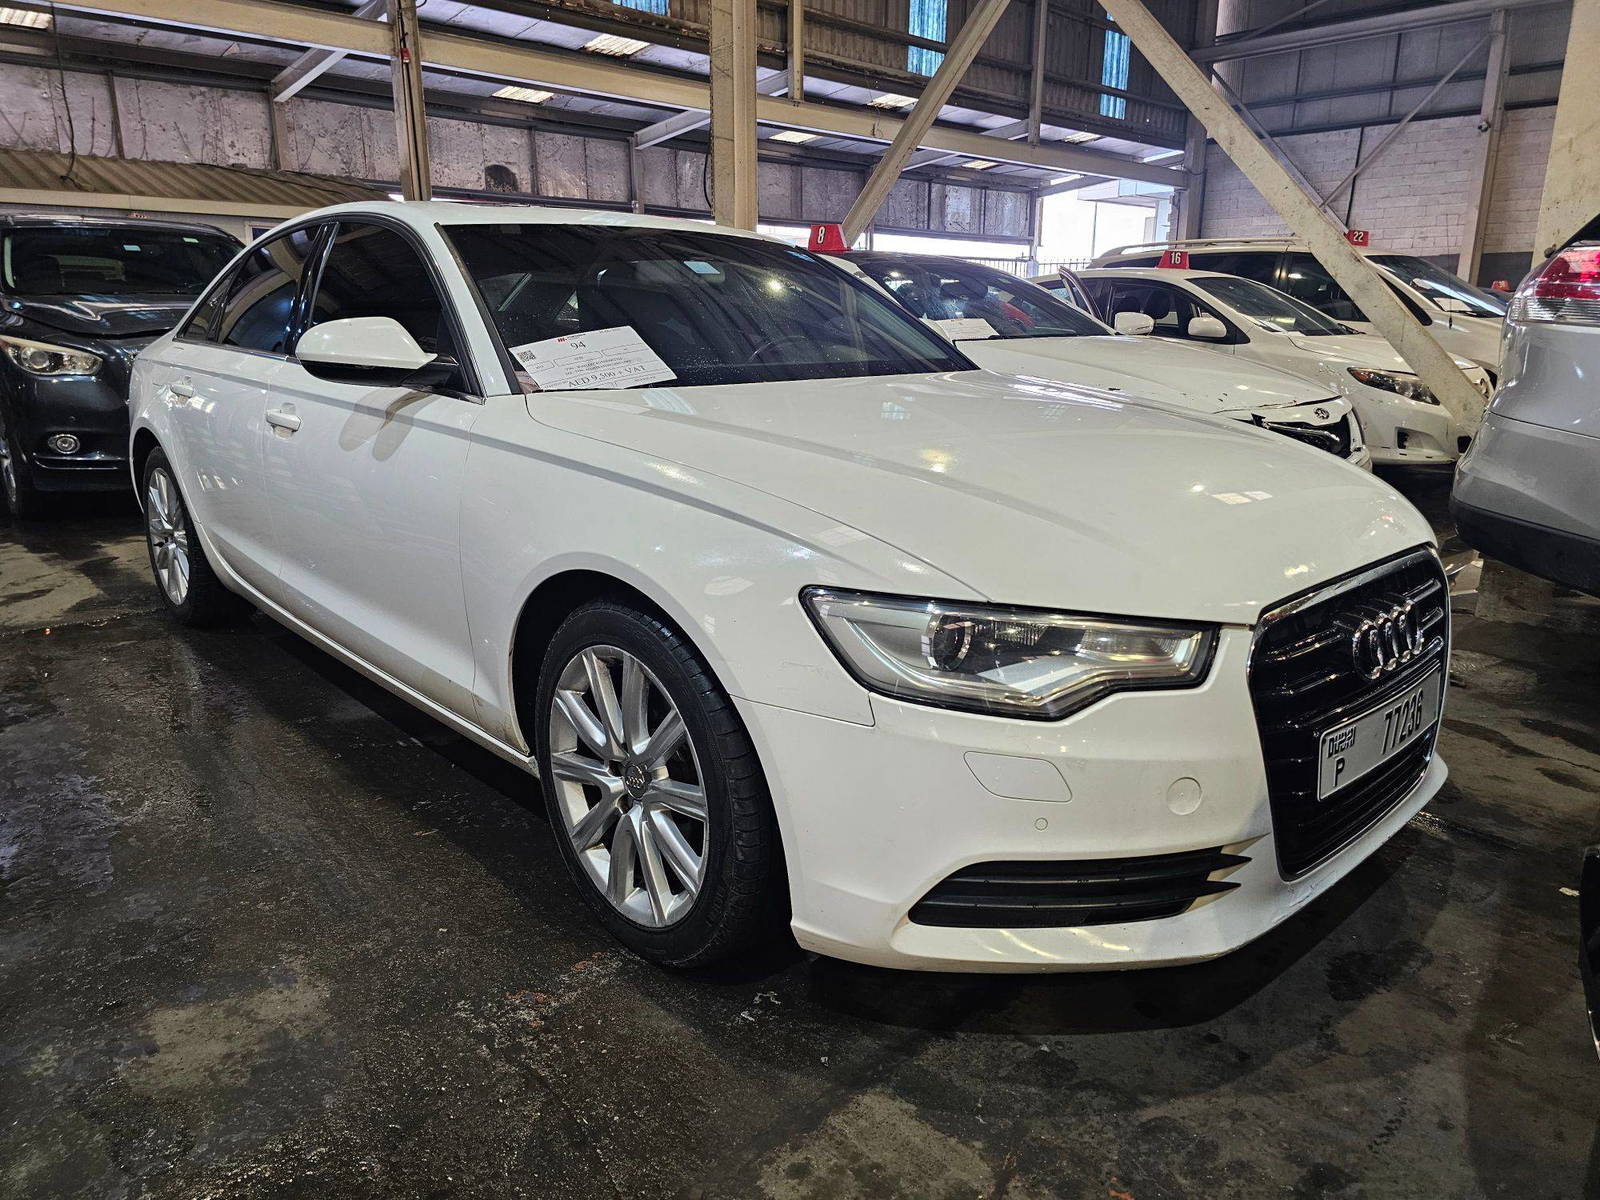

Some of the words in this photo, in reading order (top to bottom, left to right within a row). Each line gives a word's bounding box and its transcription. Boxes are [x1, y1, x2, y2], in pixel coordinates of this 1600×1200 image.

[817, 226, 826, 244] 8
[1353, 231, 1364, 242] 22
[1171, 251, 1181, 264] 16
[570, 341, 586, 350] 94
[568, 376, 590, 388] AED
[625, 365, 646, 374] VAT
[1381, 688, 1424, 755] 77236
[1333, 756, 1345, 787] P
